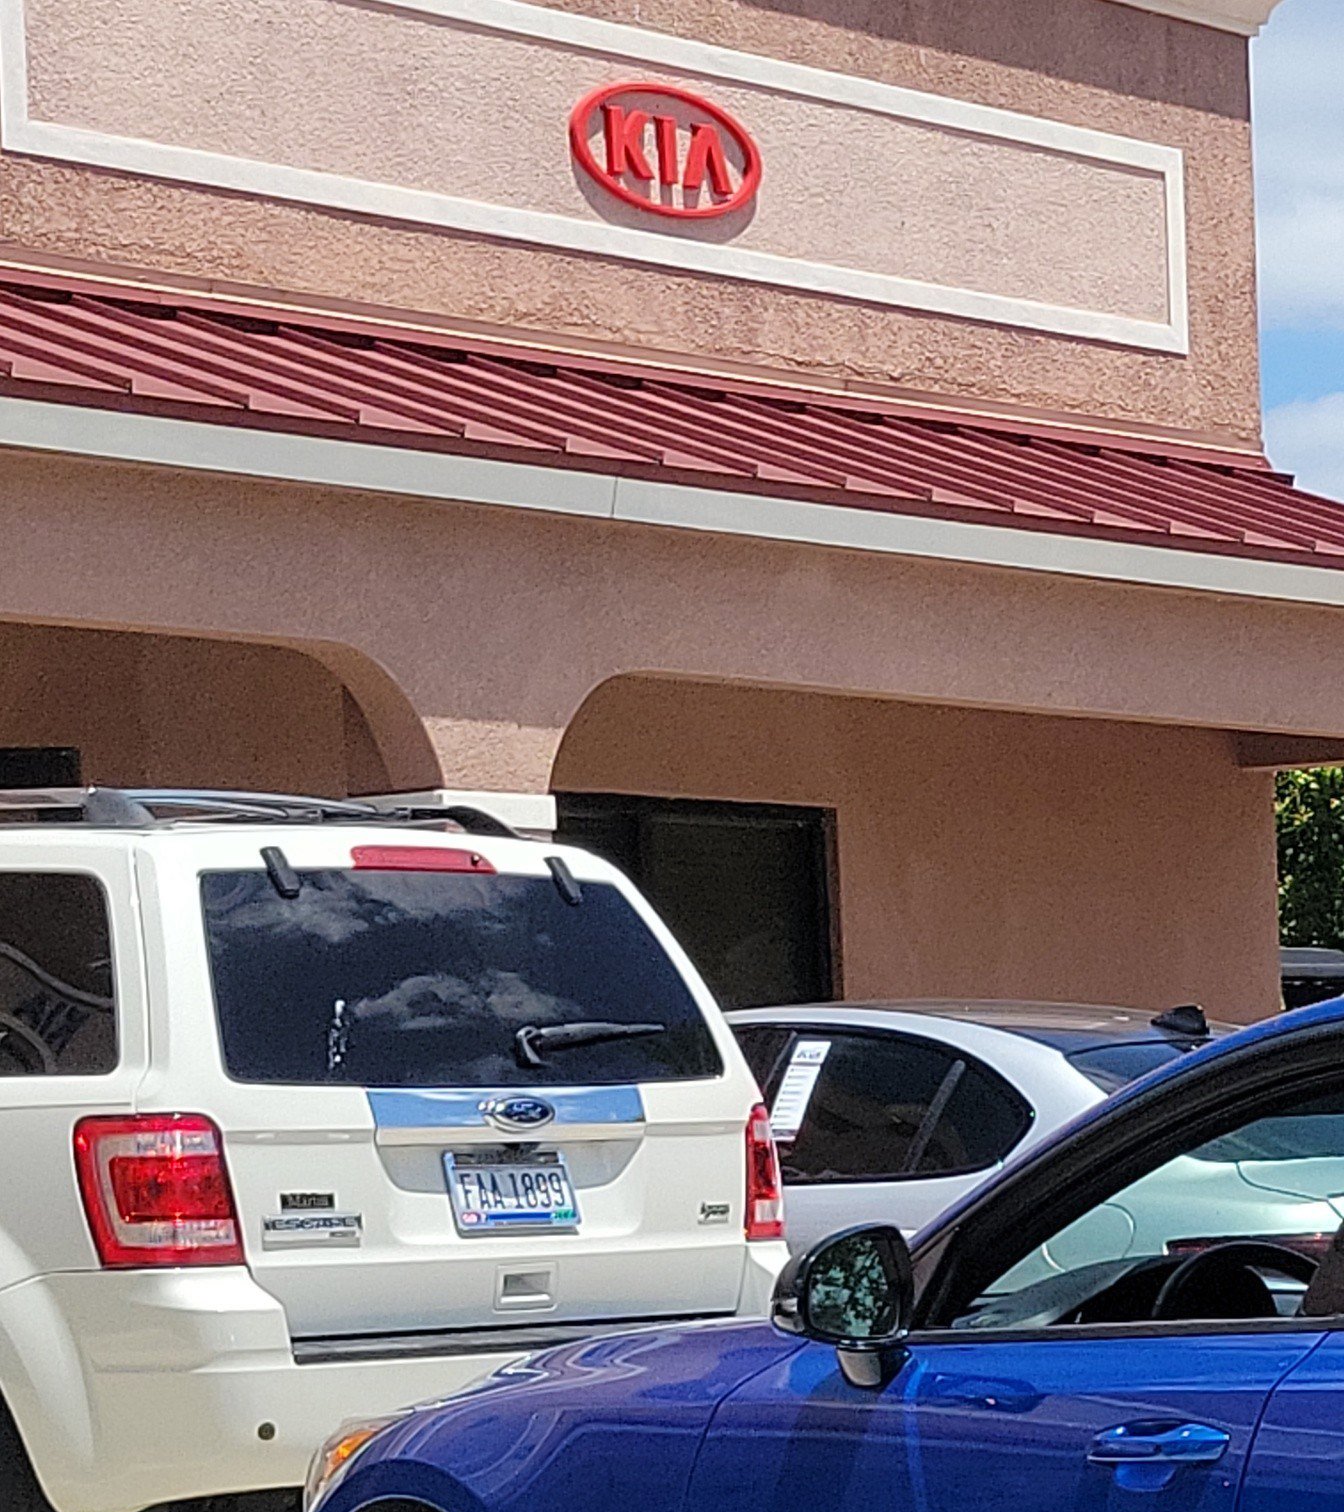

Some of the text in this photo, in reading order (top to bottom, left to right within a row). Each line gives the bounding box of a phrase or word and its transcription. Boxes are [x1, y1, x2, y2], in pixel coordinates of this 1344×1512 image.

[603, 103, 733, 195] KIA
[459, 1172, 566, 1210] FAA 1899
